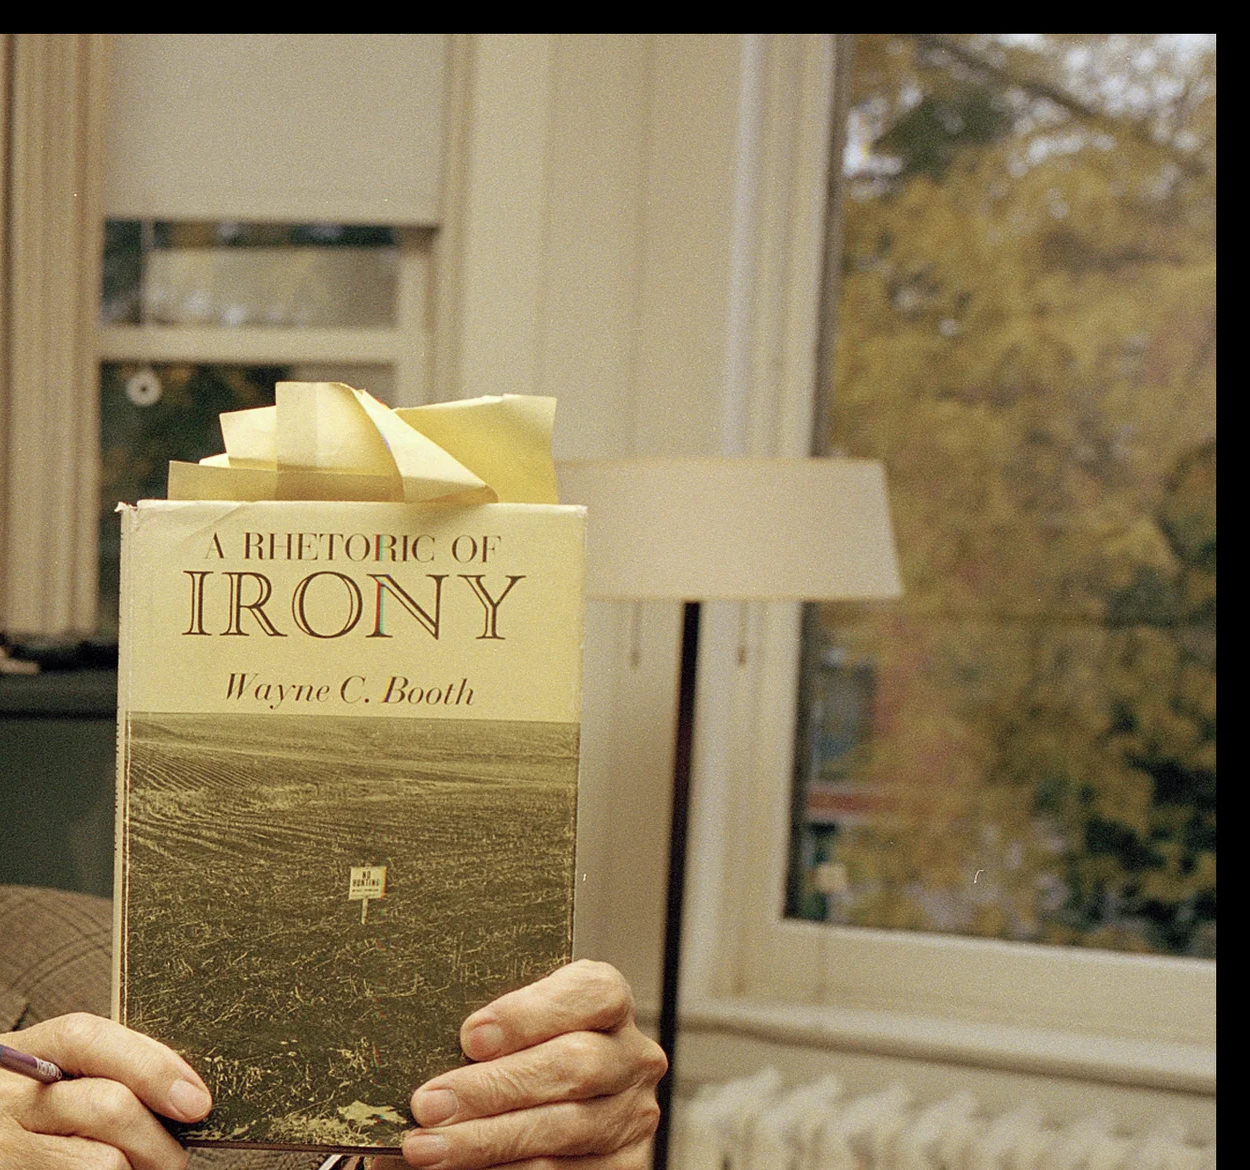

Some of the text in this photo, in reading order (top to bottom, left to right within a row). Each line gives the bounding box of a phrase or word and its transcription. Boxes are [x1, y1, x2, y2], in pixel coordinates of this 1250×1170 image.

[205, 532, 502, 564] A RHETORIC OF
[181, 570, 527, 640] IRONY
[226, 673, 475, 710] Wayne C. Booth
[352, 878, 381, 887] HUNTING
[362, 870, 371, 879] NO
